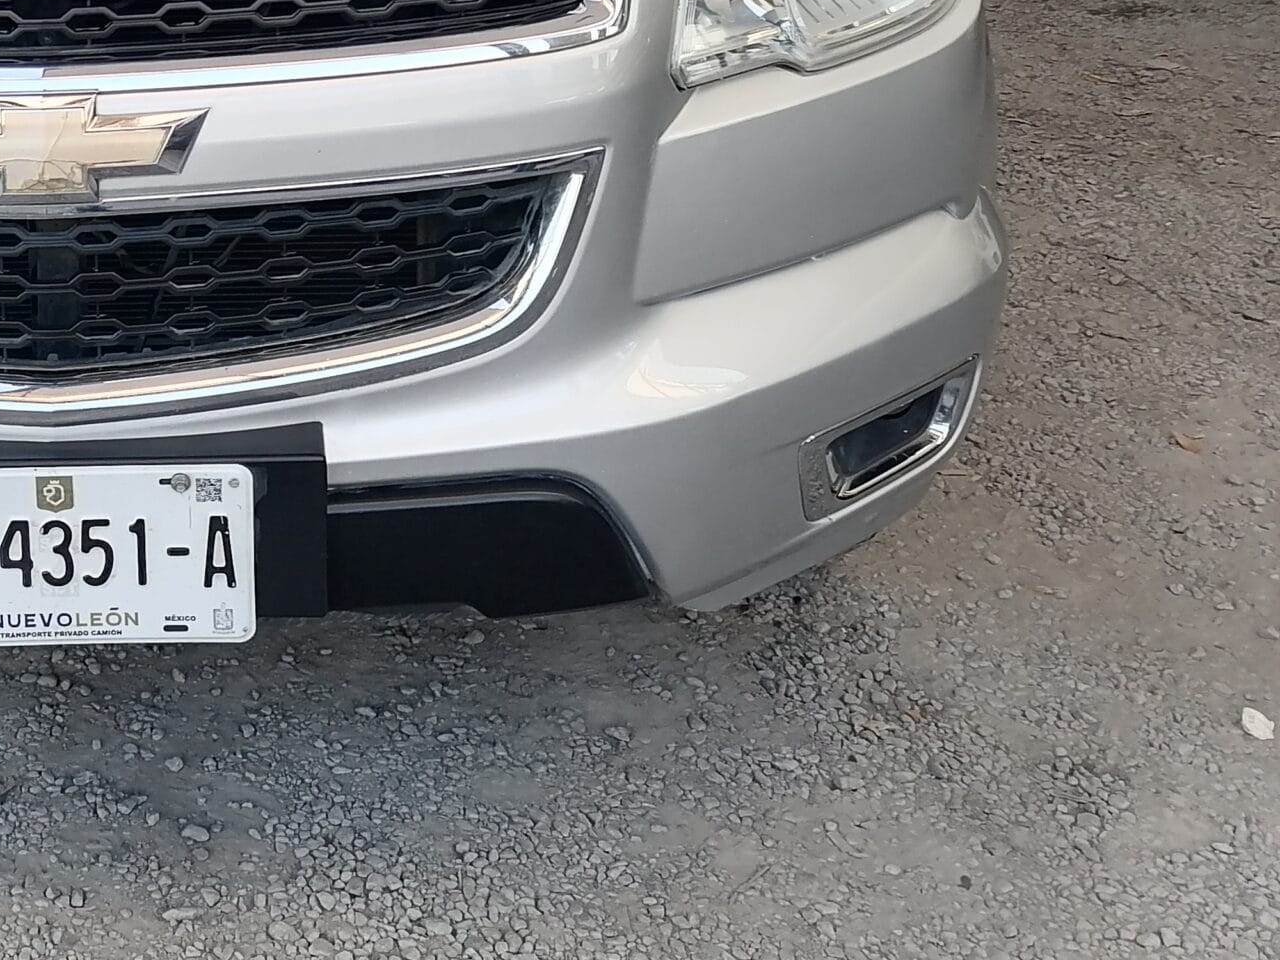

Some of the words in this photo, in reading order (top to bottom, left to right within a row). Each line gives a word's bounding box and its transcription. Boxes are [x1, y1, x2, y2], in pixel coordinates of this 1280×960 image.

[164, 613, 197, 622] MÉXICO
[0, 631, 52, 639] TRANSPORTE
[54, 630, 89, 638] PRIVADO
